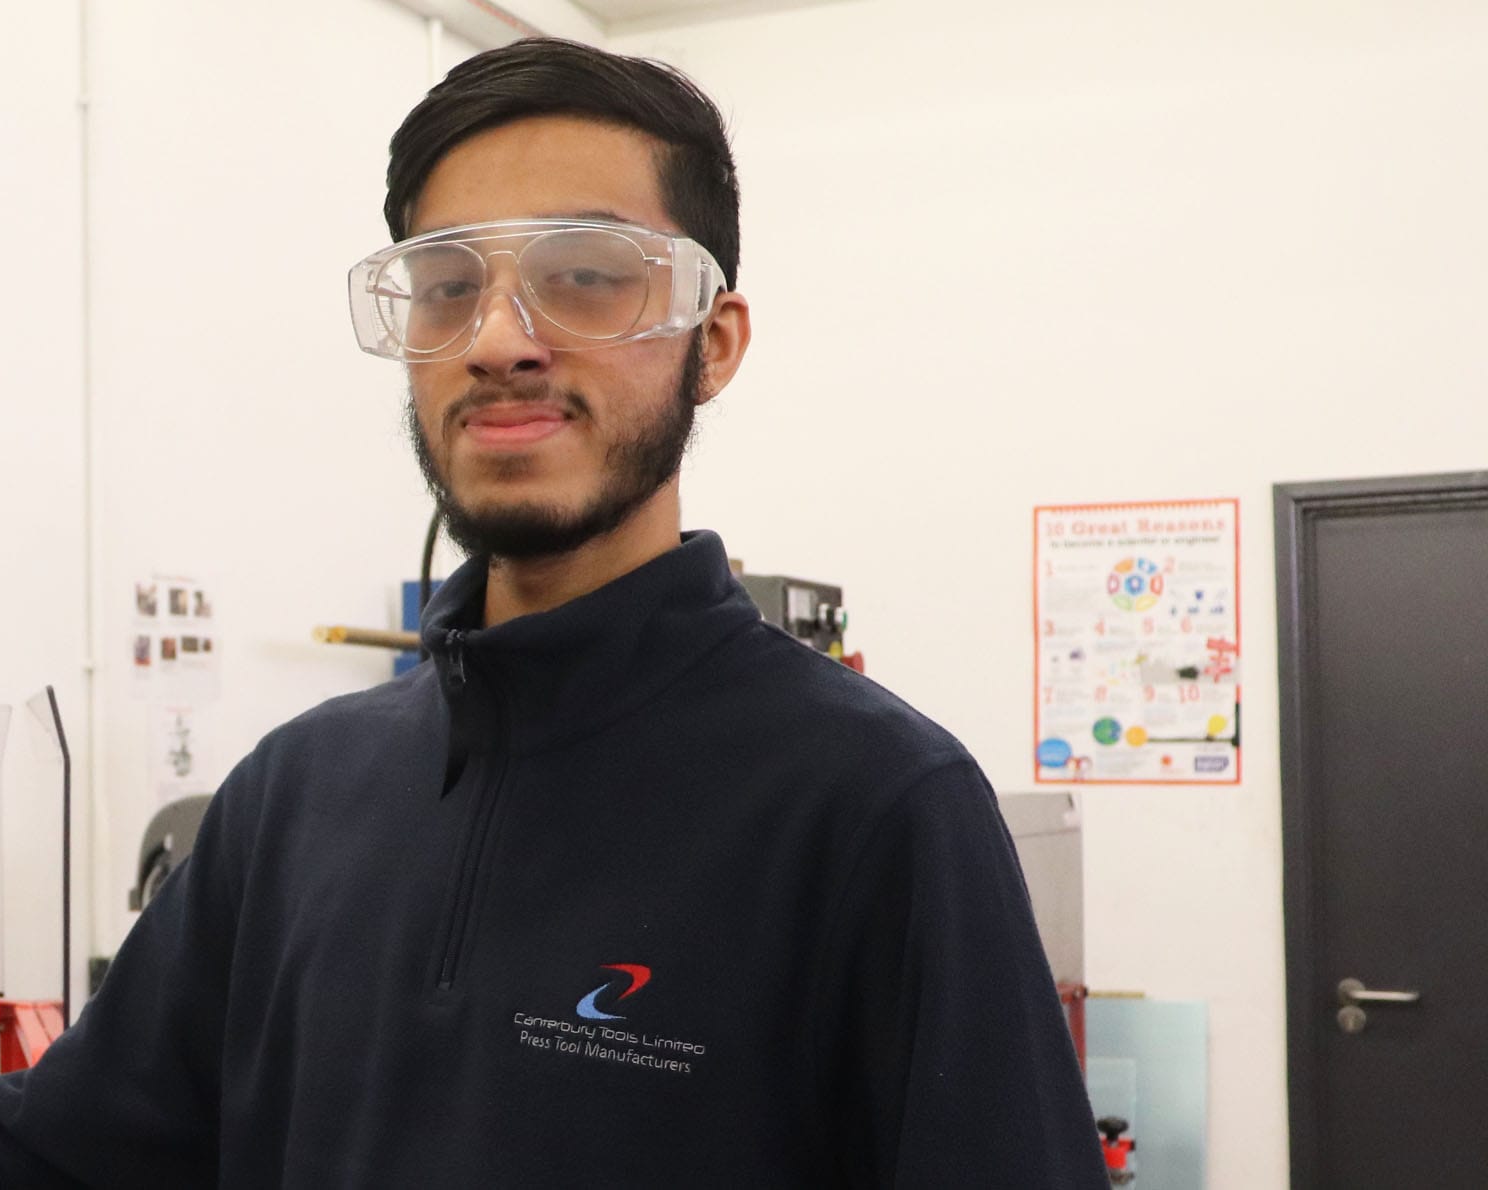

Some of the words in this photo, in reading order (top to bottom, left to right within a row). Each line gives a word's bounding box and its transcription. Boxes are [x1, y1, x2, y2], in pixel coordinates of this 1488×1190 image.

[1045, 522, 1065, 537] 10
[1071, 520, 1128, 536] Great
[1136, 518, 1225, 534] Reasons
[514, 1012, 596, 1038] Canterbury
[598, 1026, 639, 1044] Tools
[642, 1034, 706, 1055] Limited
[520, 1030, 550, 1048] Press
[554, 1035, 580, 1054] Tool
[585, 1042, 691, 1073] Manufacturers
